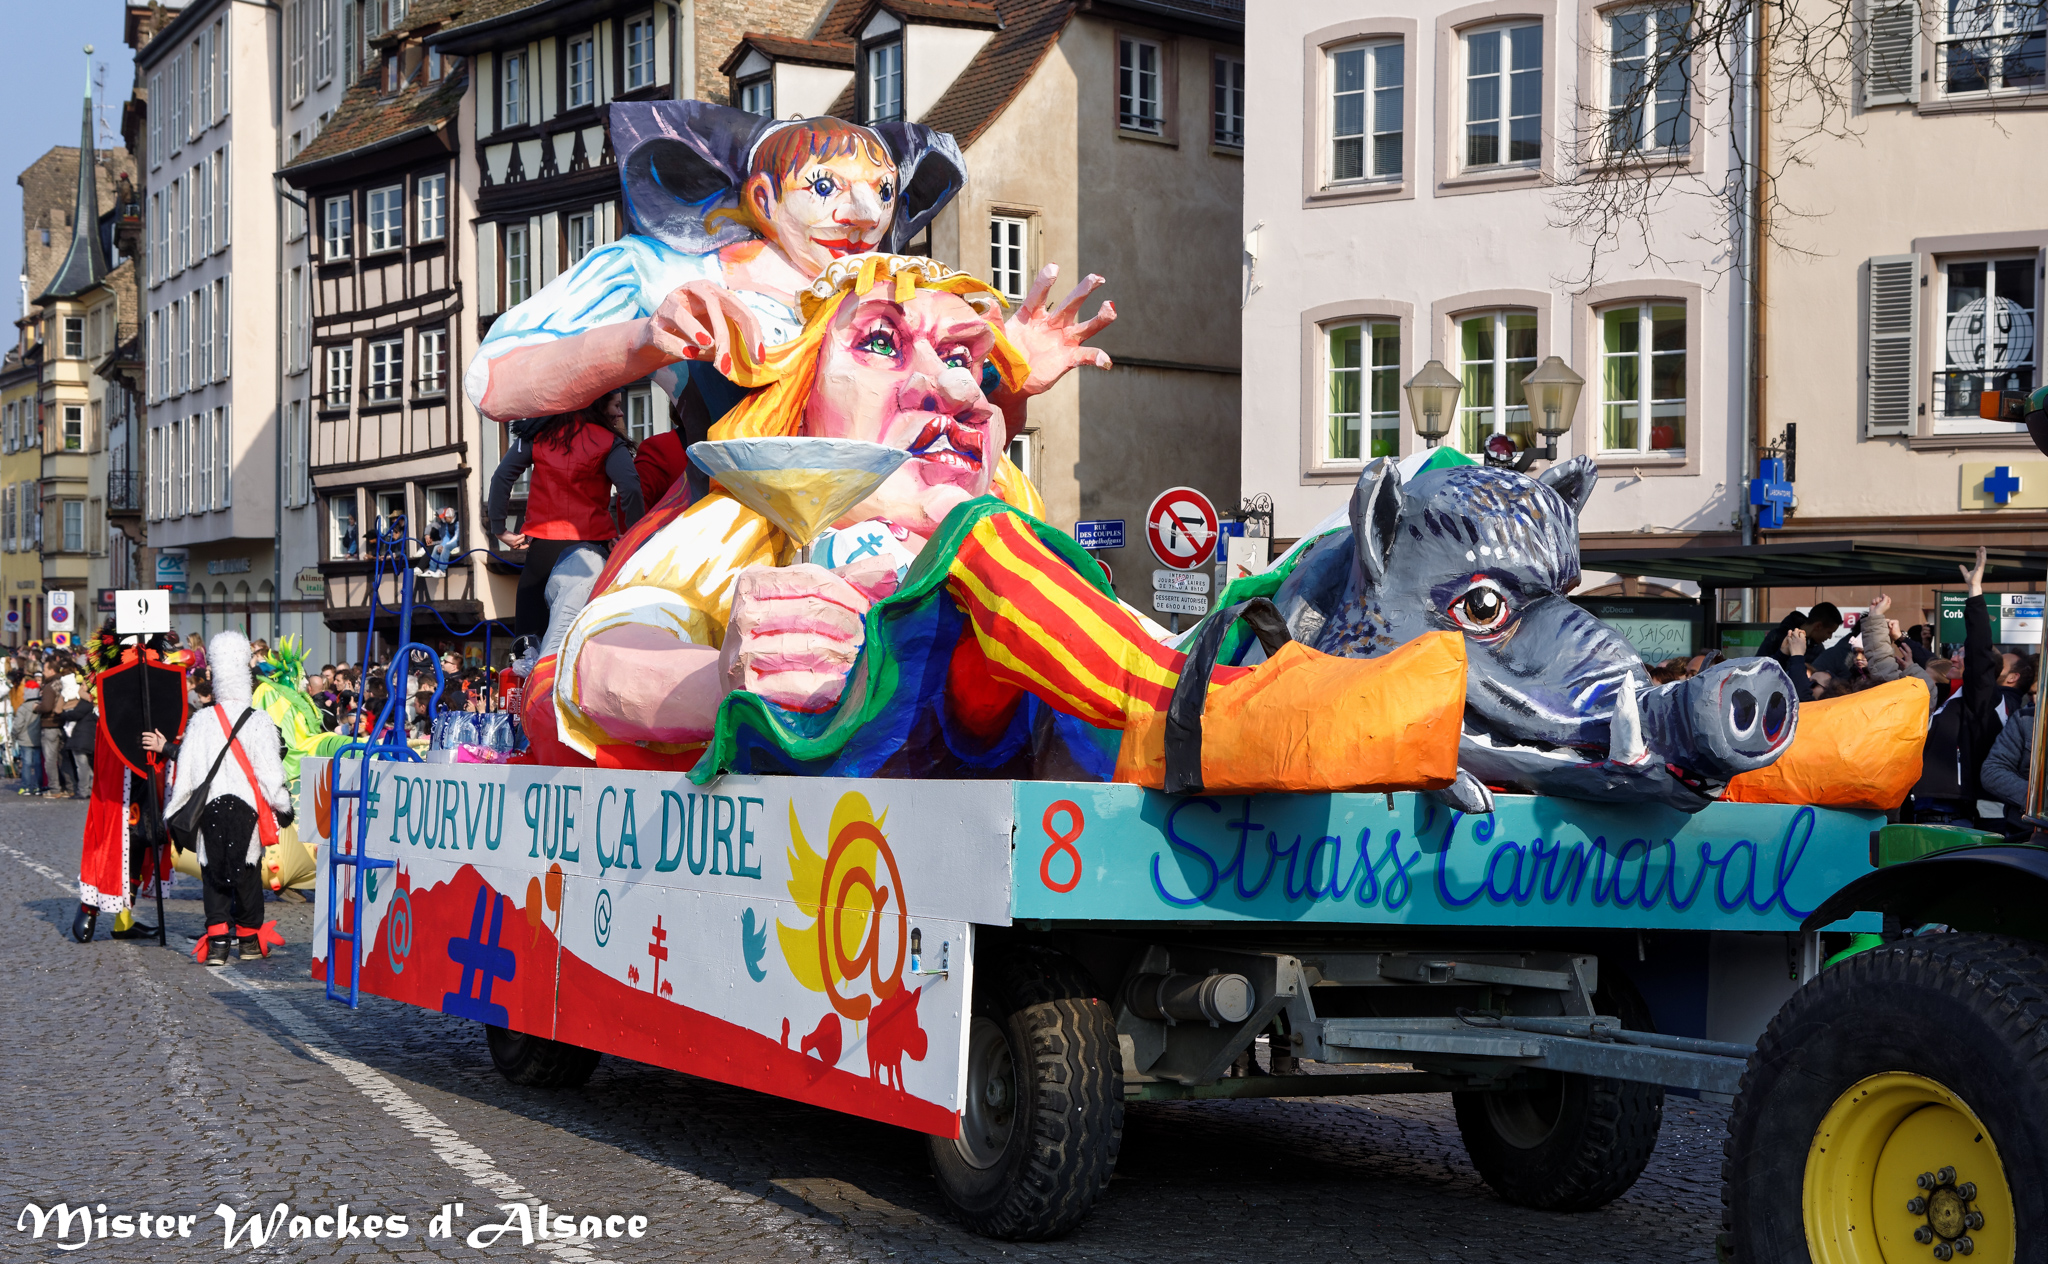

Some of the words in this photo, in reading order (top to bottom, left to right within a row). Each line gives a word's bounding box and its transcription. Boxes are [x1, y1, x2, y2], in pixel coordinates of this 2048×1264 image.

[1093, 530, 1122, 538] COUPLES
[1079, 537, 1122, 547] Kuppelhofgass
[1156, 594, 1180, 602] DESSERTE
[1181, 597, 1207, 605] AUTORISÉE
[2013, 596, 2021, 604] 10
[138, 598, 149, 616] 9
[1601, 606, 1634, 614] JCDecaux
[1943, 609, 1964, 619] Corb
[1638, 623, 1686, 645] SAISON
[390, 775, 507, 852] POURVU
[524, 782, 583, 864] QUE
[596, 785, 642, 877] ÇA
[655, 789, 765, 881] DURE
[1040, 799, 1085, 894] 8
